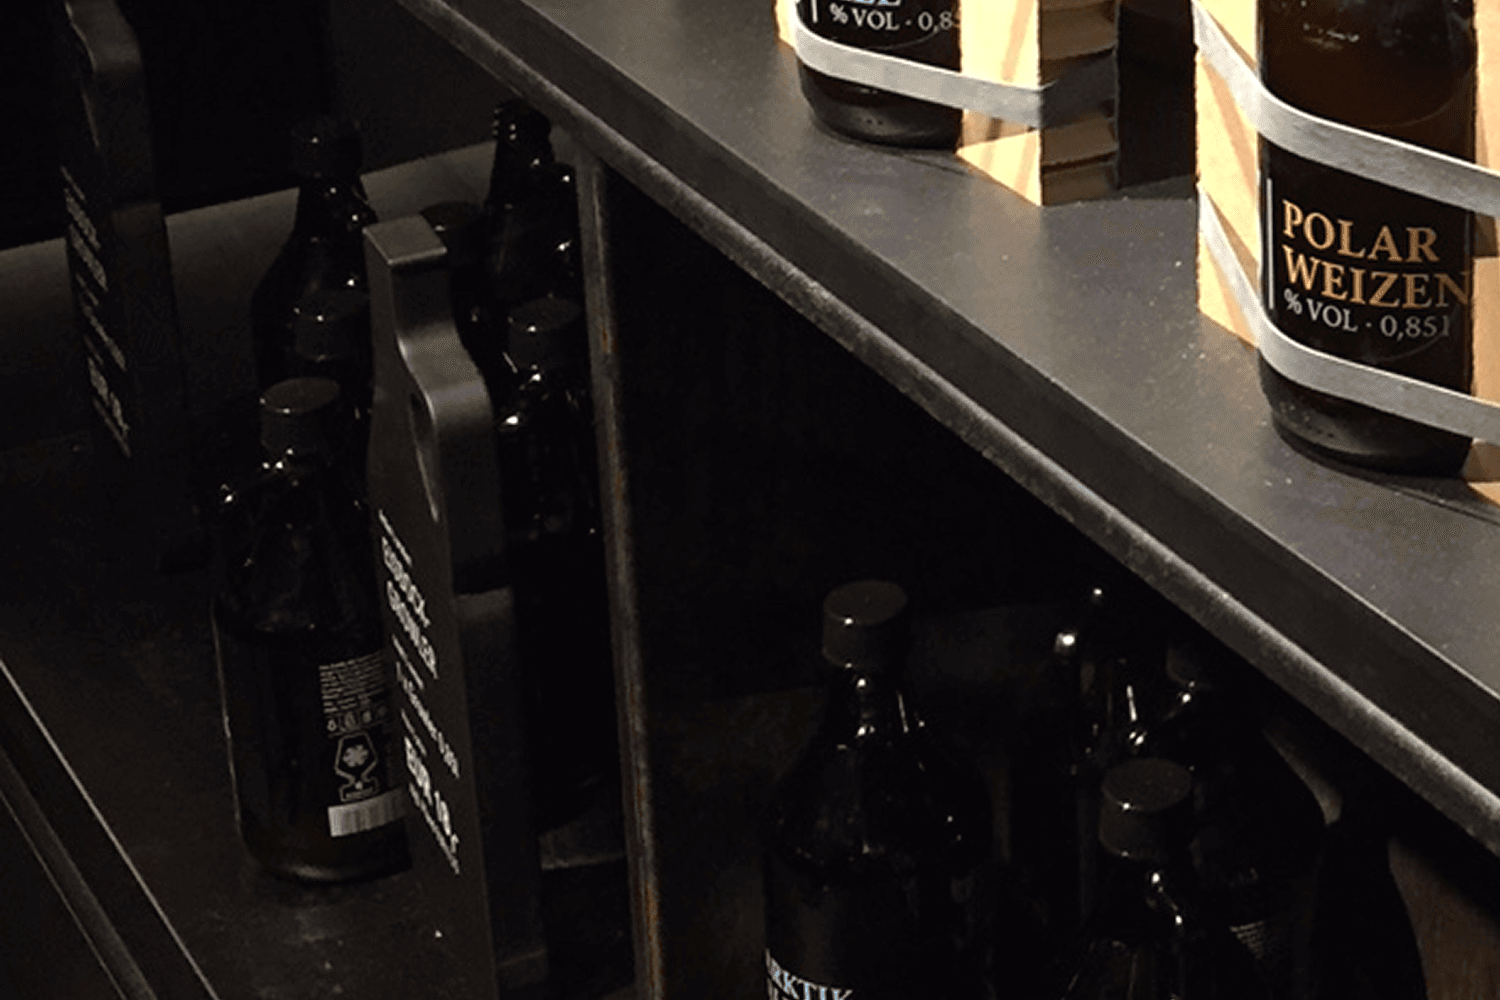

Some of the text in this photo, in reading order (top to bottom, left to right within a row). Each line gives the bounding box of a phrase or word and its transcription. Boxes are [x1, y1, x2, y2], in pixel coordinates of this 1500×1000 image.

[829, 1, 850, 26] %
[851, 7, 900, 32] VOL
[1282, 198, 1441, 264] POLAR
[1282, 244, 1472, 310] WEIZEN
[1284, 287, 1303, 316] %
[1305, 297, 1358, 333] VOL
